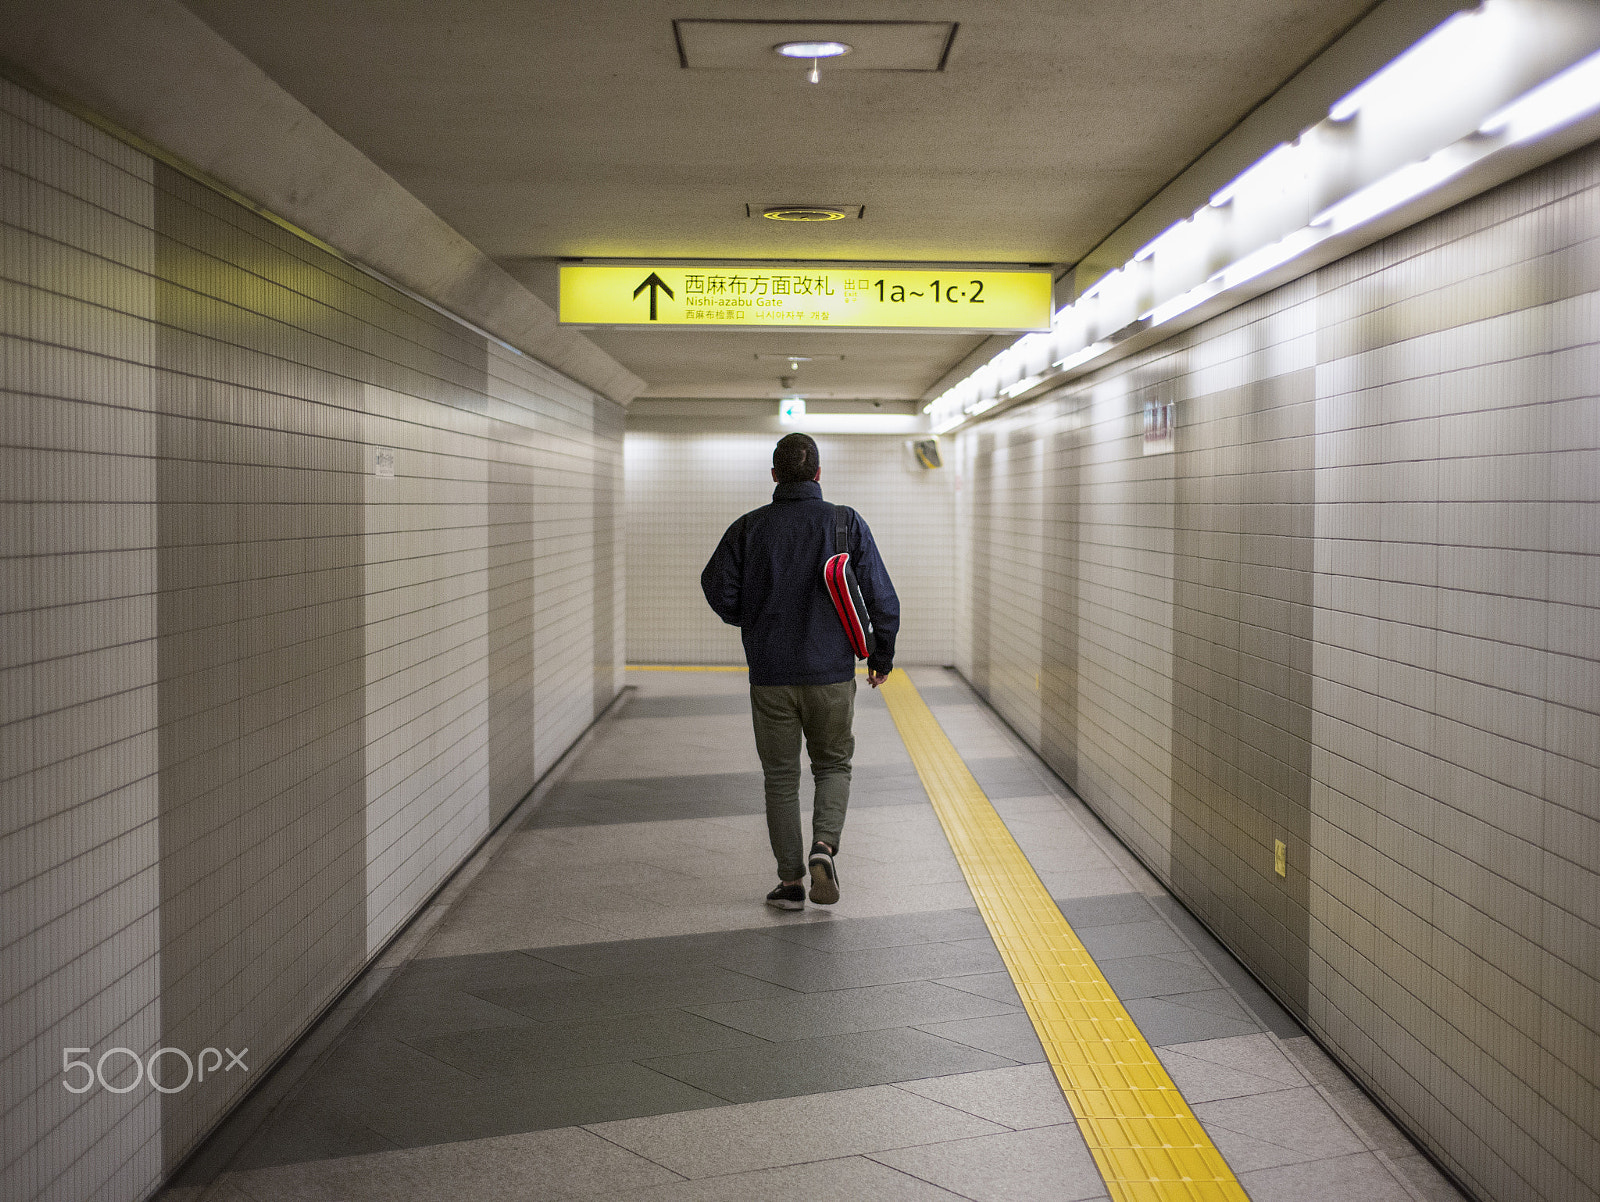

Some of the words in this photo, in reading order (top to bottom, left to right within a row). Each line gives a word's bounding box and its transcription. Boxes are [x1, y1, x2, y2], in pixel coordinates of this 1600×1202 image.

[685, 274, 835, 296] 西麻布方面改札
[844, 278, 869, 290] 出口
[686, 296, 752, 307] Nishi-azabu
[756, 297, 783, 307] Gate
